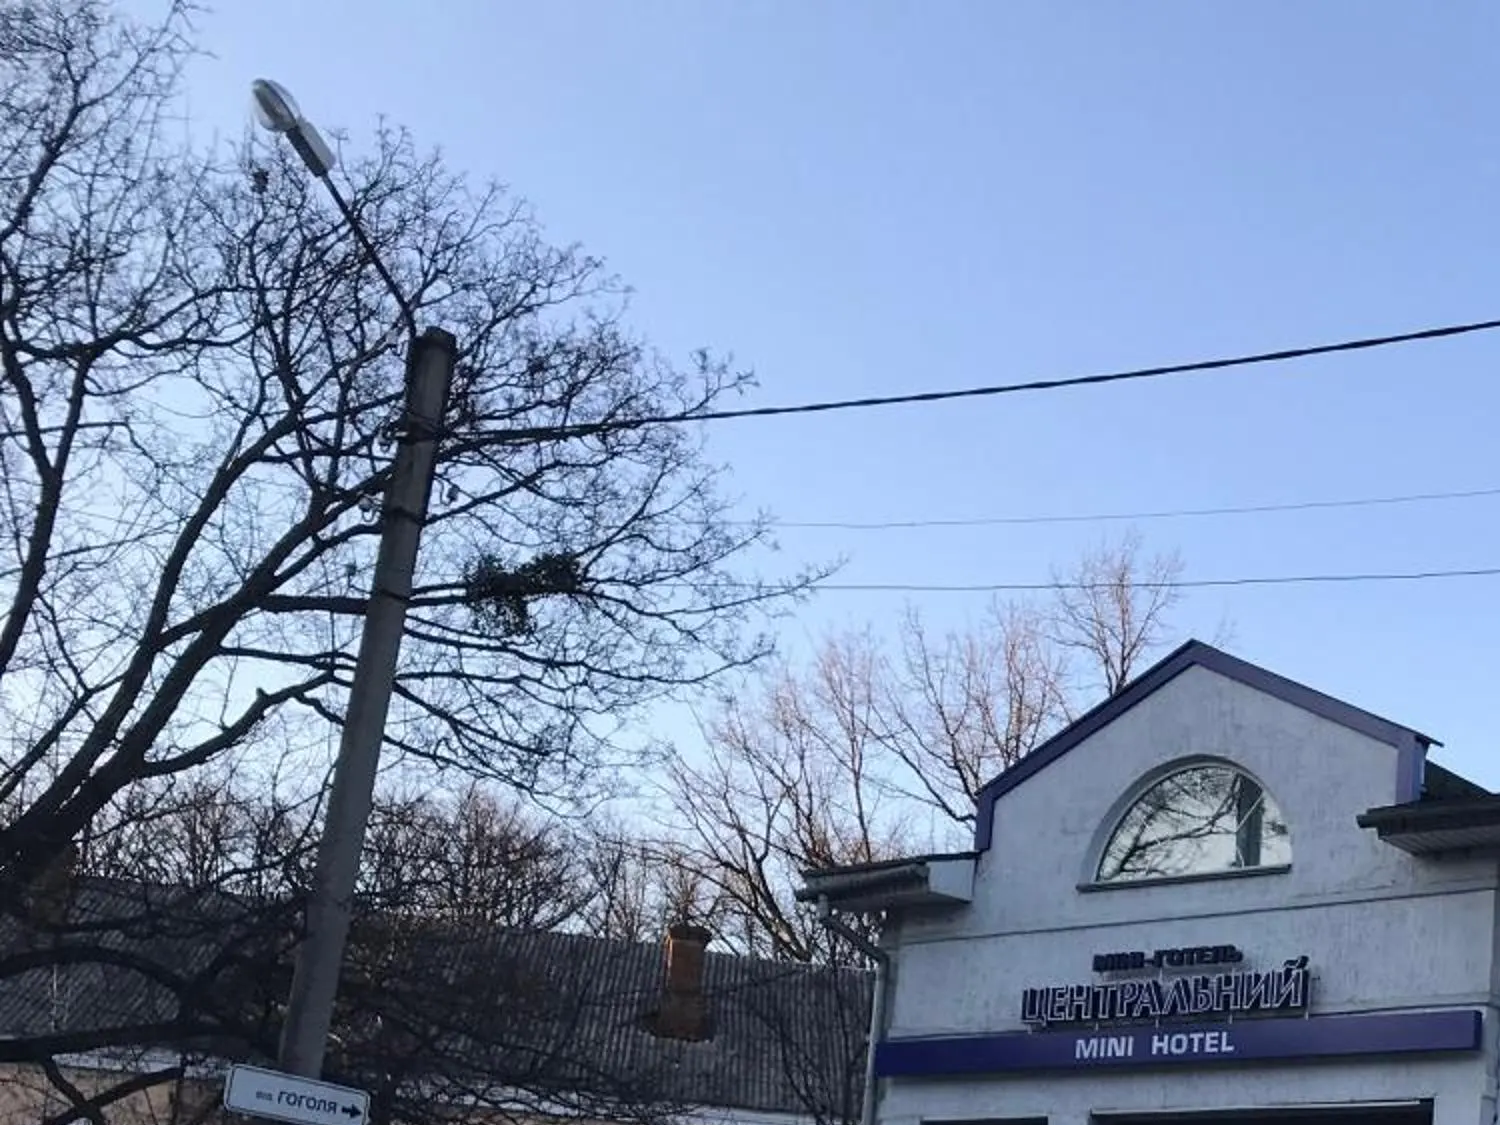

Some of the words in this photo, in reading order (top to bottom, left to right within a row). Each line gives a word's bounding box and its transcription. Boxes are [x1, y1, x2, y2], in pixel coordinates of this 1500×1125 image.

[1021, 956, 1309, 1026] ЦЕНТРАЛЬНИЙ
[1075, 1036, 1135, 1059] MINI
[1151, 1031, 1235, 1055] HOTEL
[277, 1091, 338, 1114] ГОГОЛЯ
